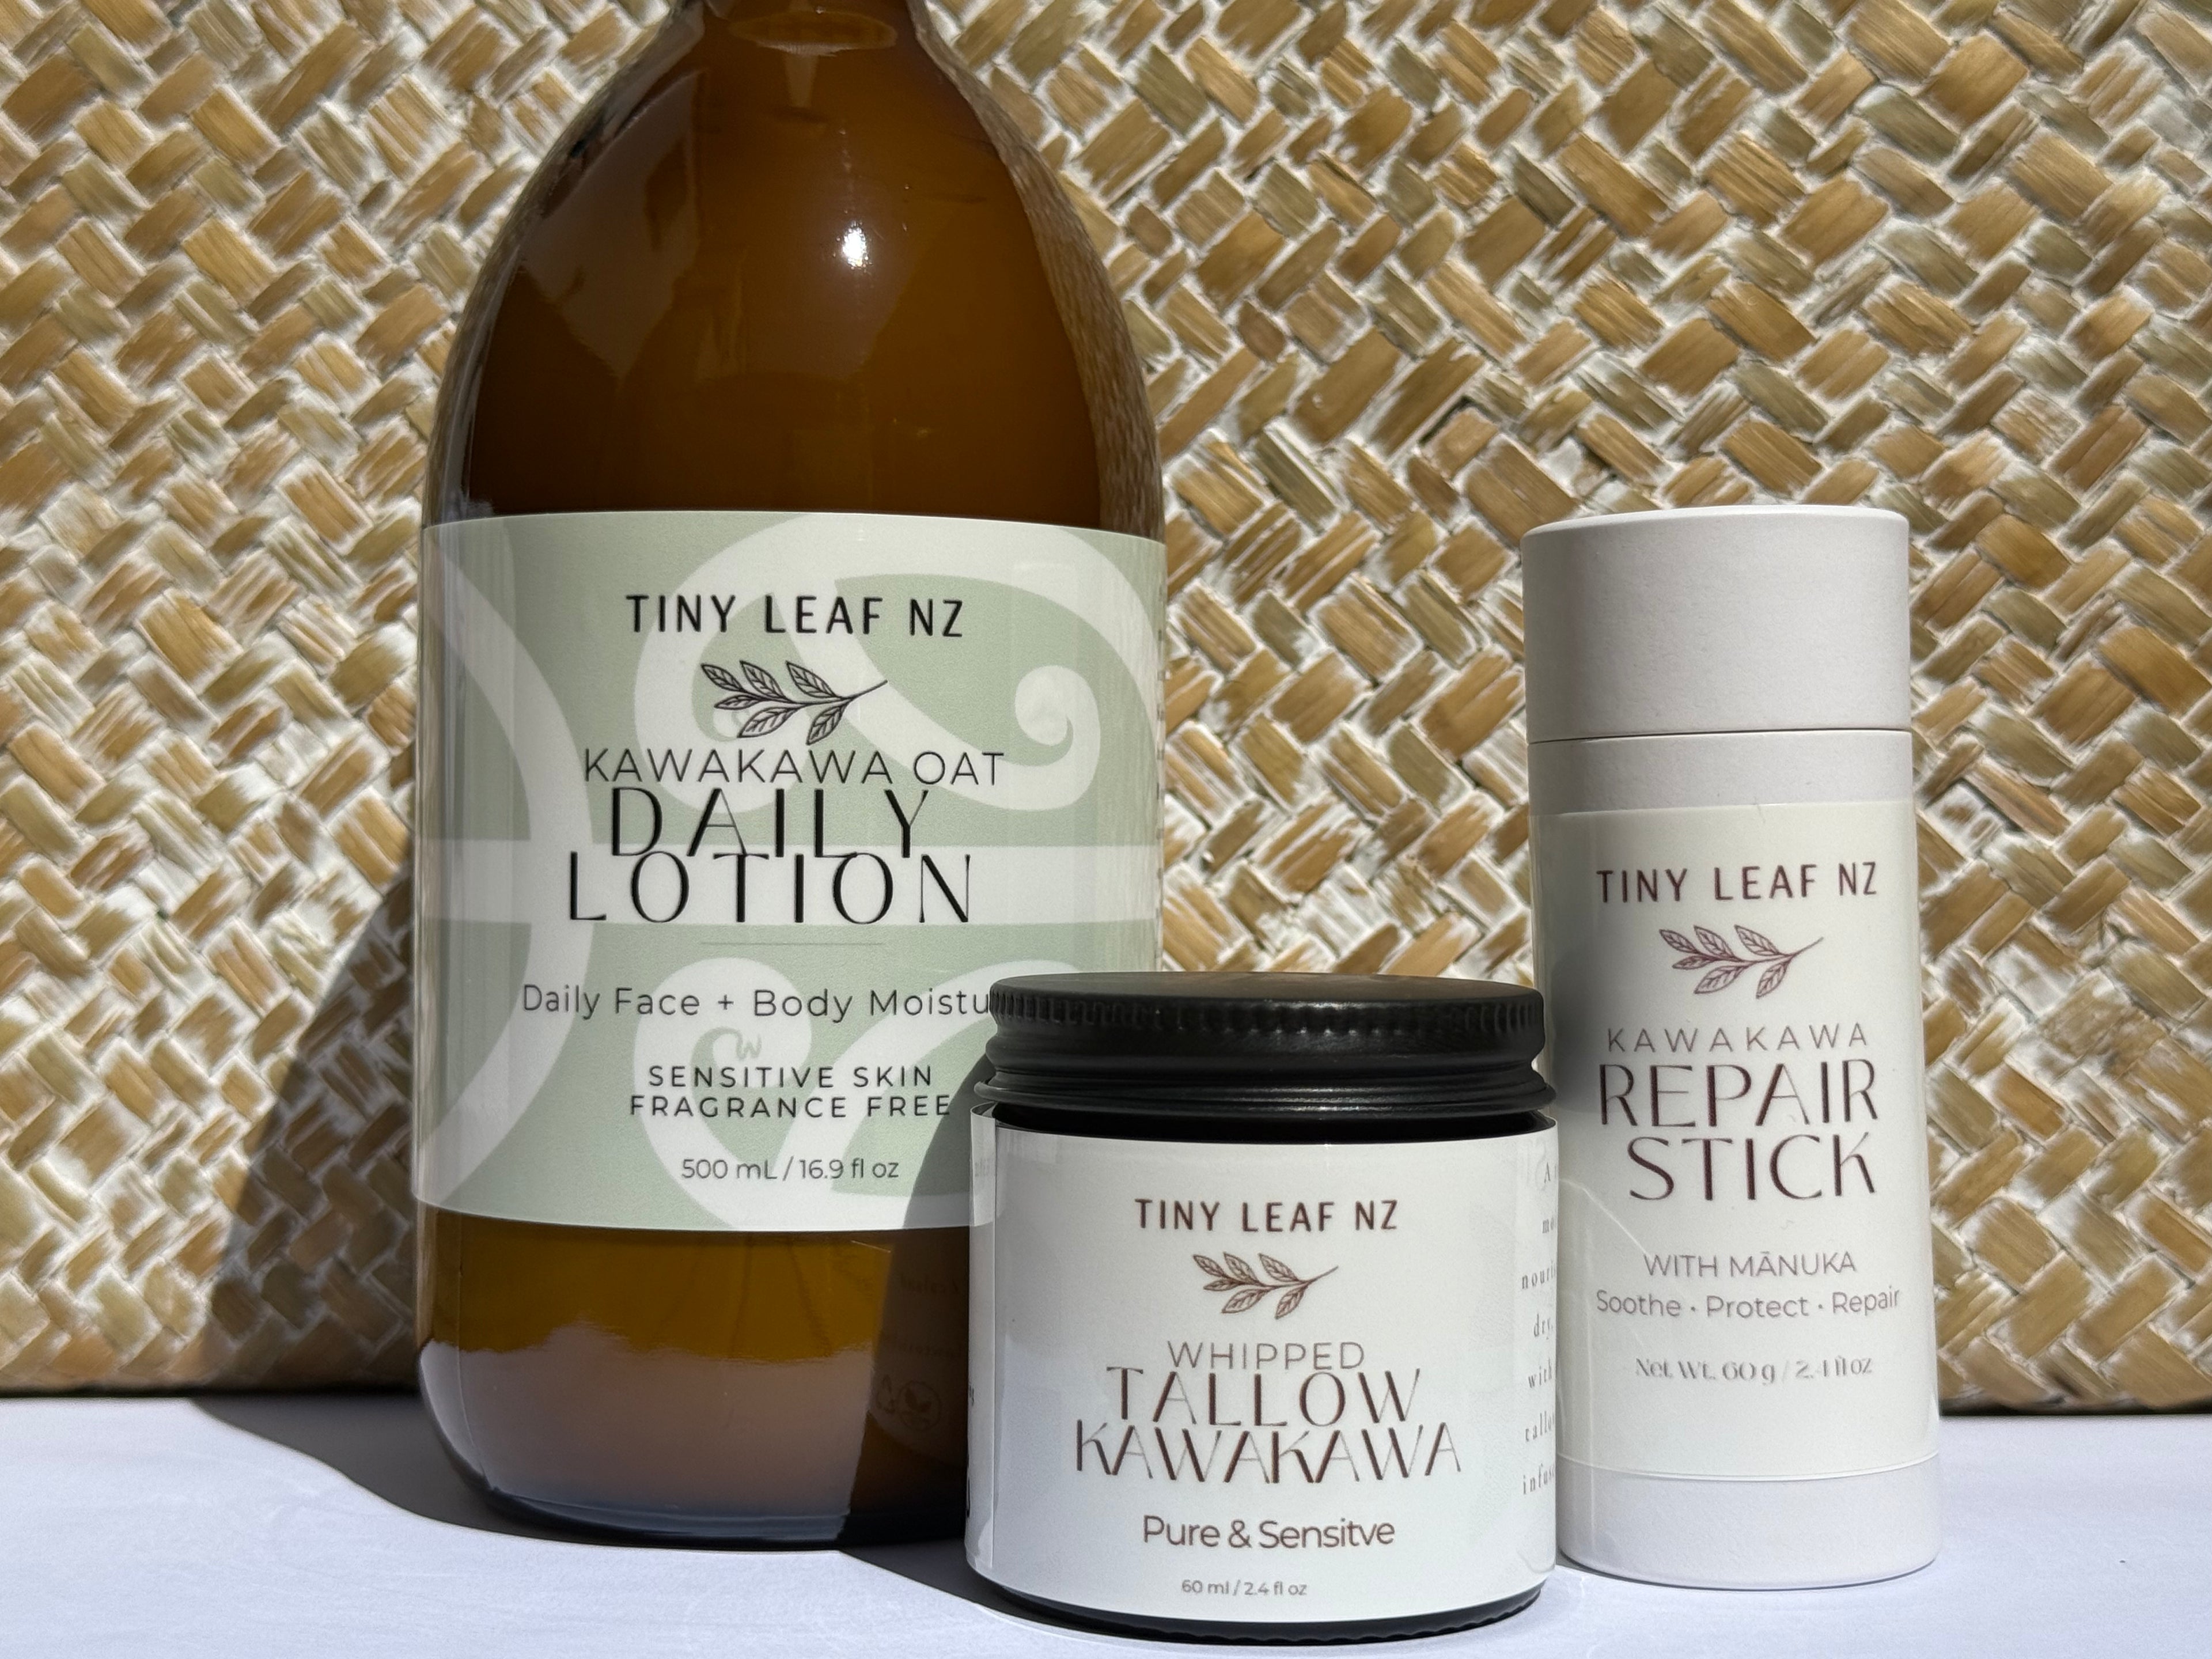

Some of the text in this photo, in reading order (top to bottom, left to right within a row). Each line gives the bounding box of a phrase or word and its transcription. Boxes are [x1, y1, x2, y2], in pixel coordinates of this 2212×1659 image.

[626, 594, 963, 638] TINY LEAF NZ
[585, 747, 1005, 786] KAWAKAWA OAT
[611, 787, 929, 858] DAILY
[570, 850, 972, 924] LOTION
[1596, 861, 1877, 903] TINY LEAF NZ
[523, 984, 989, 1024] Daily Face + Body Moistu
[1608, 1022, 1867, 1053] KAWAKAWA
[649, 1065, 931, 1089] SENSITIVE SKIN
[1599, 1058, 1878, 1127] REPAIR
[630, 1094, 950, 1119] FRAGRANCE FREE
[681, 1158, 729, 1180] 500
[736, 1158, 778, 1180] mL
[799, 1159, 844, 1180] 16.9
[851, 1157, 864, 1179] fl
[872, 1162, 899, 1179] oz
[1627, 1131, 1876, 1201] STICK
[1135, 1198, 1397, 1233] TINY LEAF NZ
[1521, 1259, 1556, 1290] nouri
[1643, 1251, 1857, 1278] WITH MĀNUKA
[1596, 1289, 1681, 1318] Soothe
[1706, 1295, 1809, 1319] Protect
[1832, 1285, 1900, 1316] Repair
[1166, 1340, 1365, 1370] WHIPPED
[1635, 1356, 1672, 1379] Net
[1720, 1358, 1757, 1382] 60
[1849, 1356, 1873, 1376] oz
[1105, 1366, 1421, 1426] TALLOW
[1075, 1419, 1462, 1484] KAWAKAWA
[1143, 1514, 1395, 1549] Pure & Sensitve
[1181, 1579, 1203, 1594] 60
[1207, 1581, 1230, 1594] ml
[1244, 1581, 1270, 1596] 2.4
[1273, 1581, 1283, 1596] fl
[1287, 1584, 1308, 1596] oz
